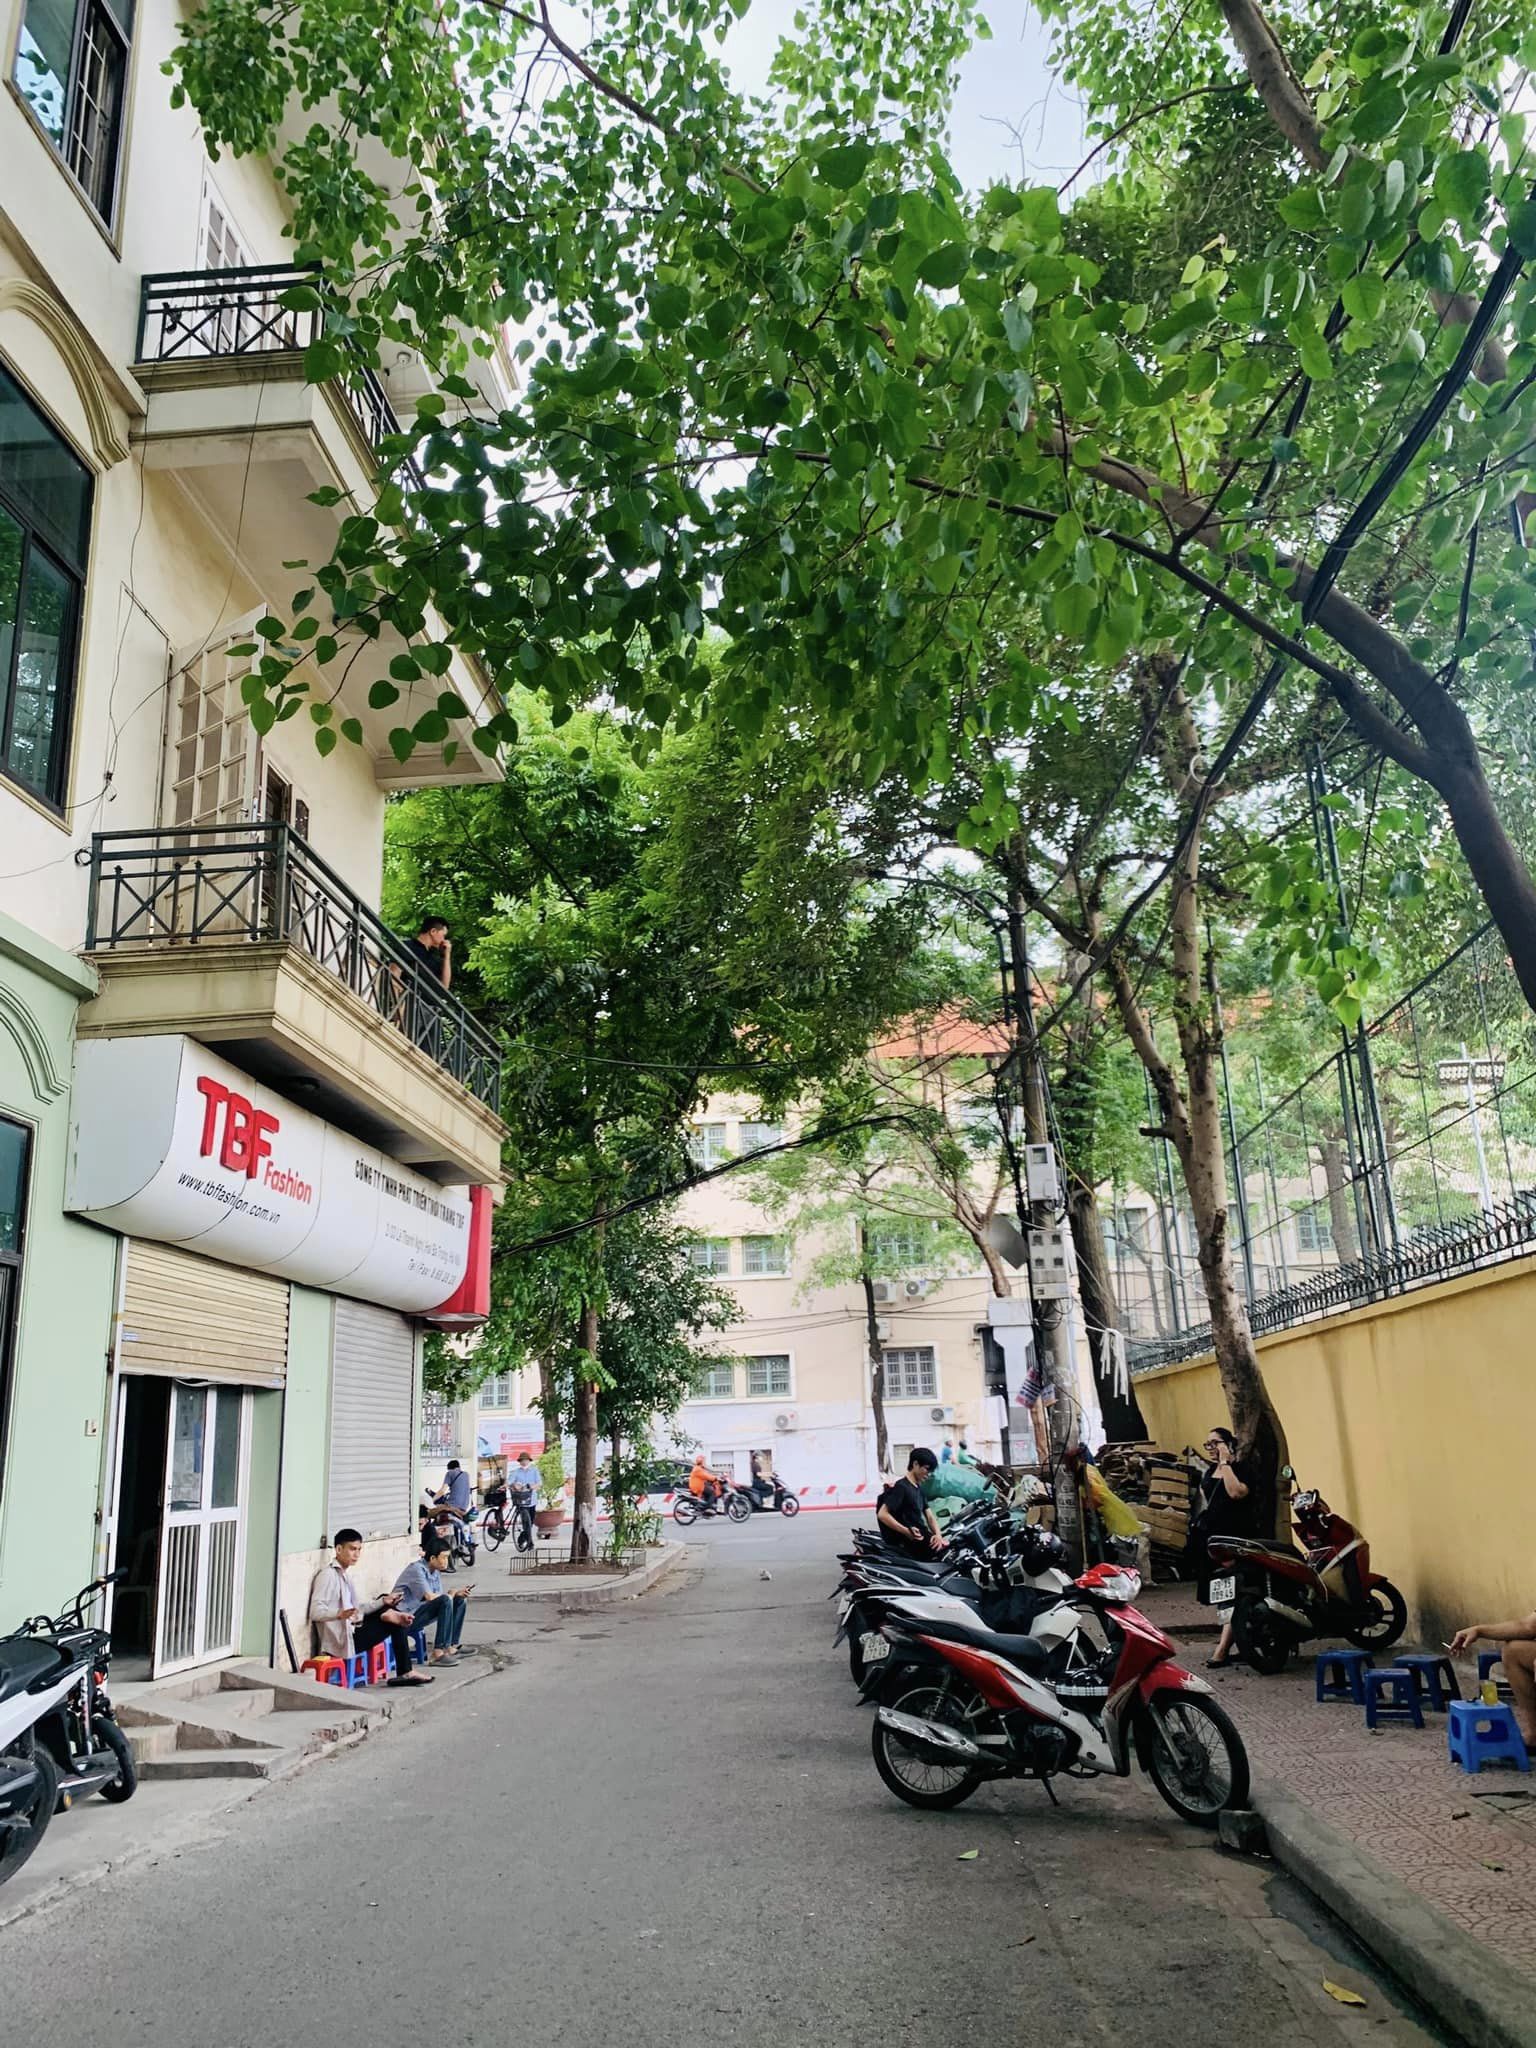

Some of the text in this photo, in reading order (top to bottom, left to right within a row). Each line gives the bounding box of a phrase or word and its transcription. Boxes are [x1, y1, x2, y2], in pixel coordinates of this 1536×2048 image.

[197, 1076, 280, 1179] TBF
[177, 1172, 281, 1225] www.tbffashion.com.vn
[264, 1160, 312, 1205] Fashion
